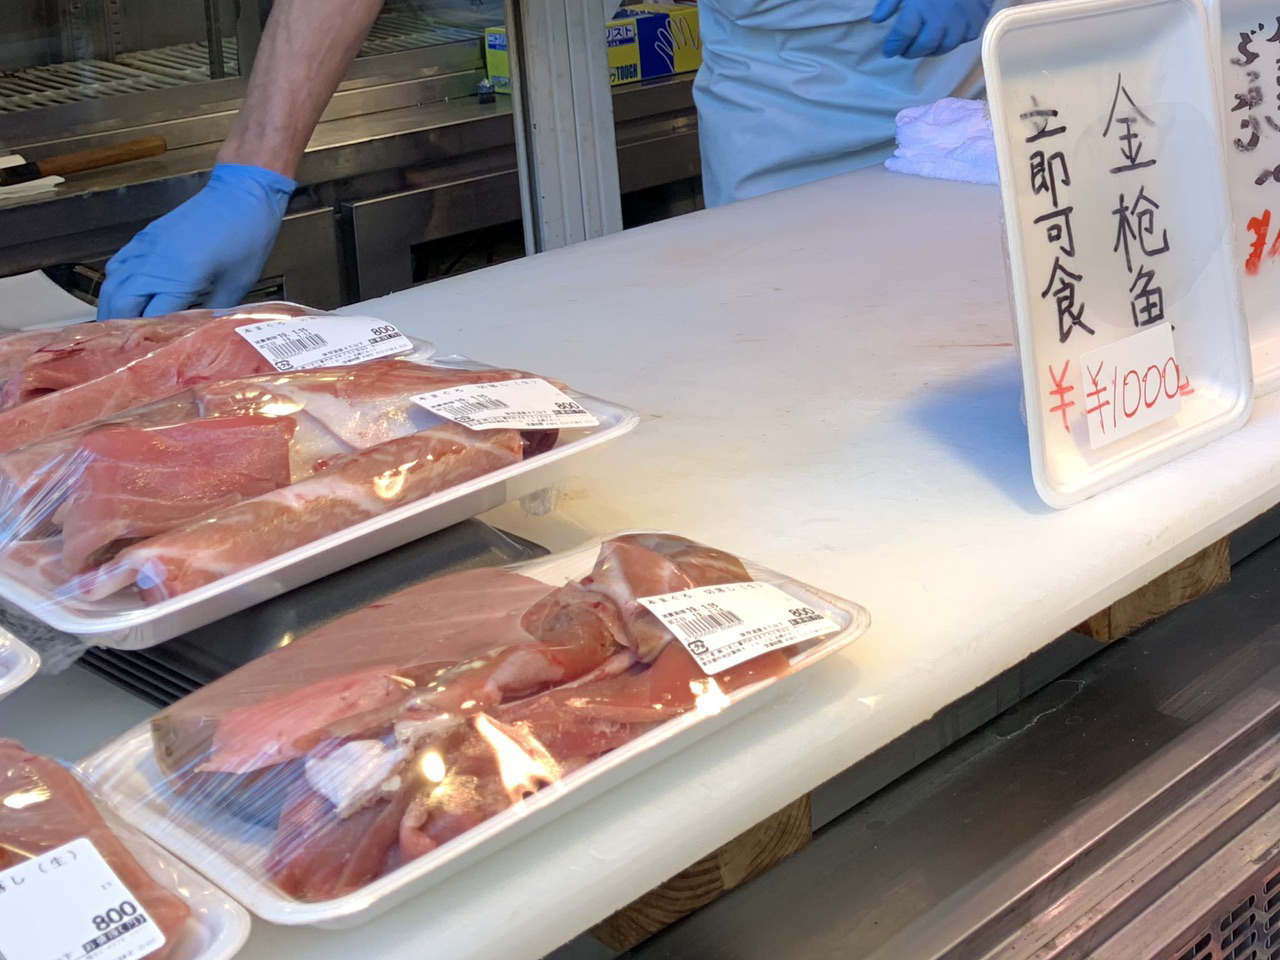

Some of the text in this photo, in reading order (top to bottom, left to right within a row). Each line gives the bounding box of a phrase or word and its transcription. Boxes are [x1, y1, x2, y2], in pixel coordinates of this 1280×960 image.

[1019, 95, 1096, 344] 立即可食
[370, 324, 396, 337] 800
[553, 401, 580, 411] 800
[788, 607, 816, 619] 800
[92, 900, 138, 932] 800
